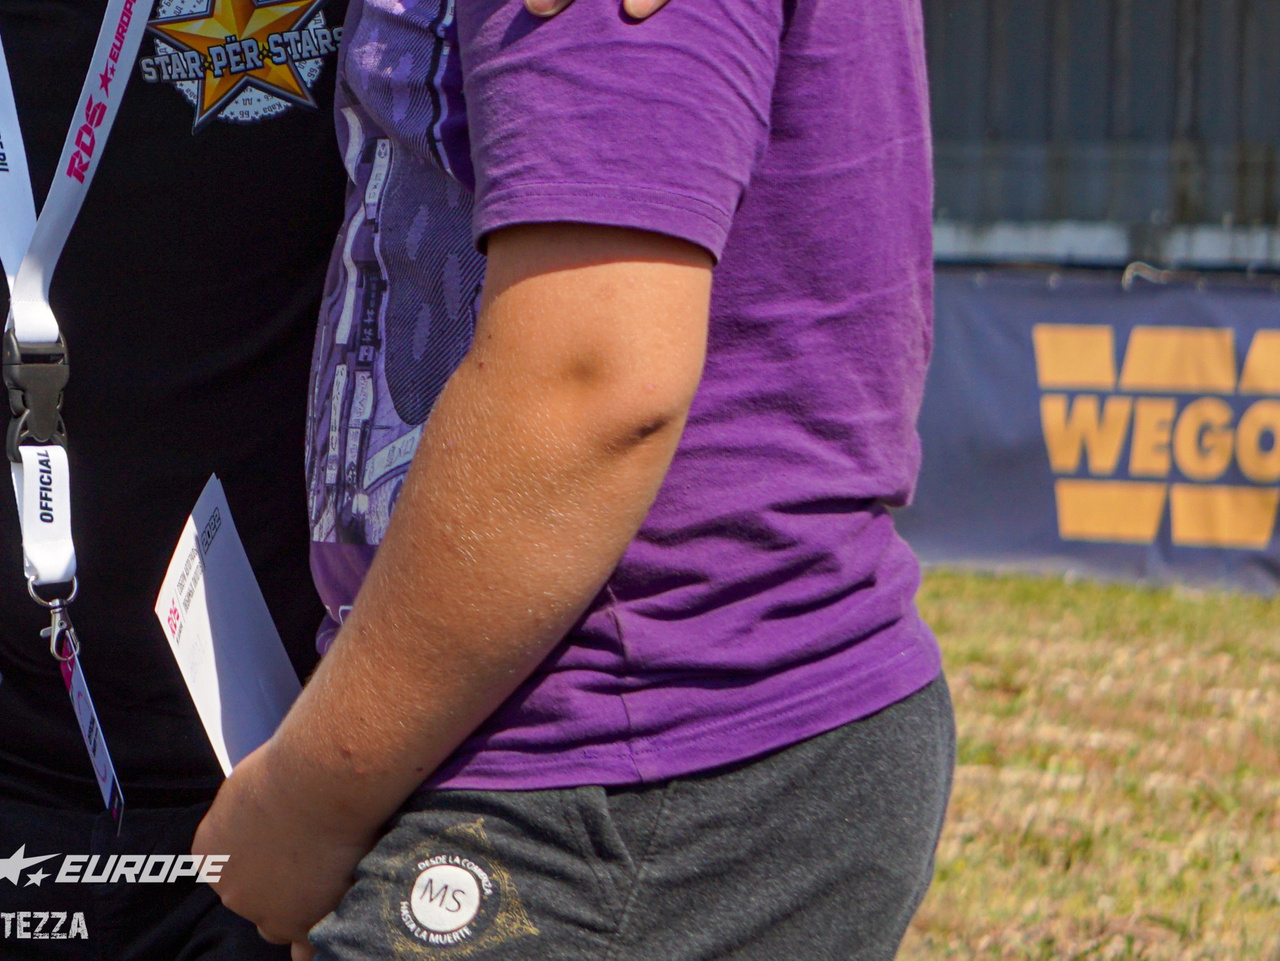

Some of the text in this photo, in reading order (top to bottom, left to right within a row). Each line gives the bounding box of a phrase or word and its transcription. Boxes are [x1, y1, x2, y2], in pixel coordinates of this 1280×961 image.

[141, 50, 205, 82] STAR
[66, 94, 107, 184] RDS
[1039, 393, 1280, 483] WEGO
[39, 450, 54, 523] OFFICIAL
[200, 507, 221, 555] 2022
[420, 878, 466, 912] MS
